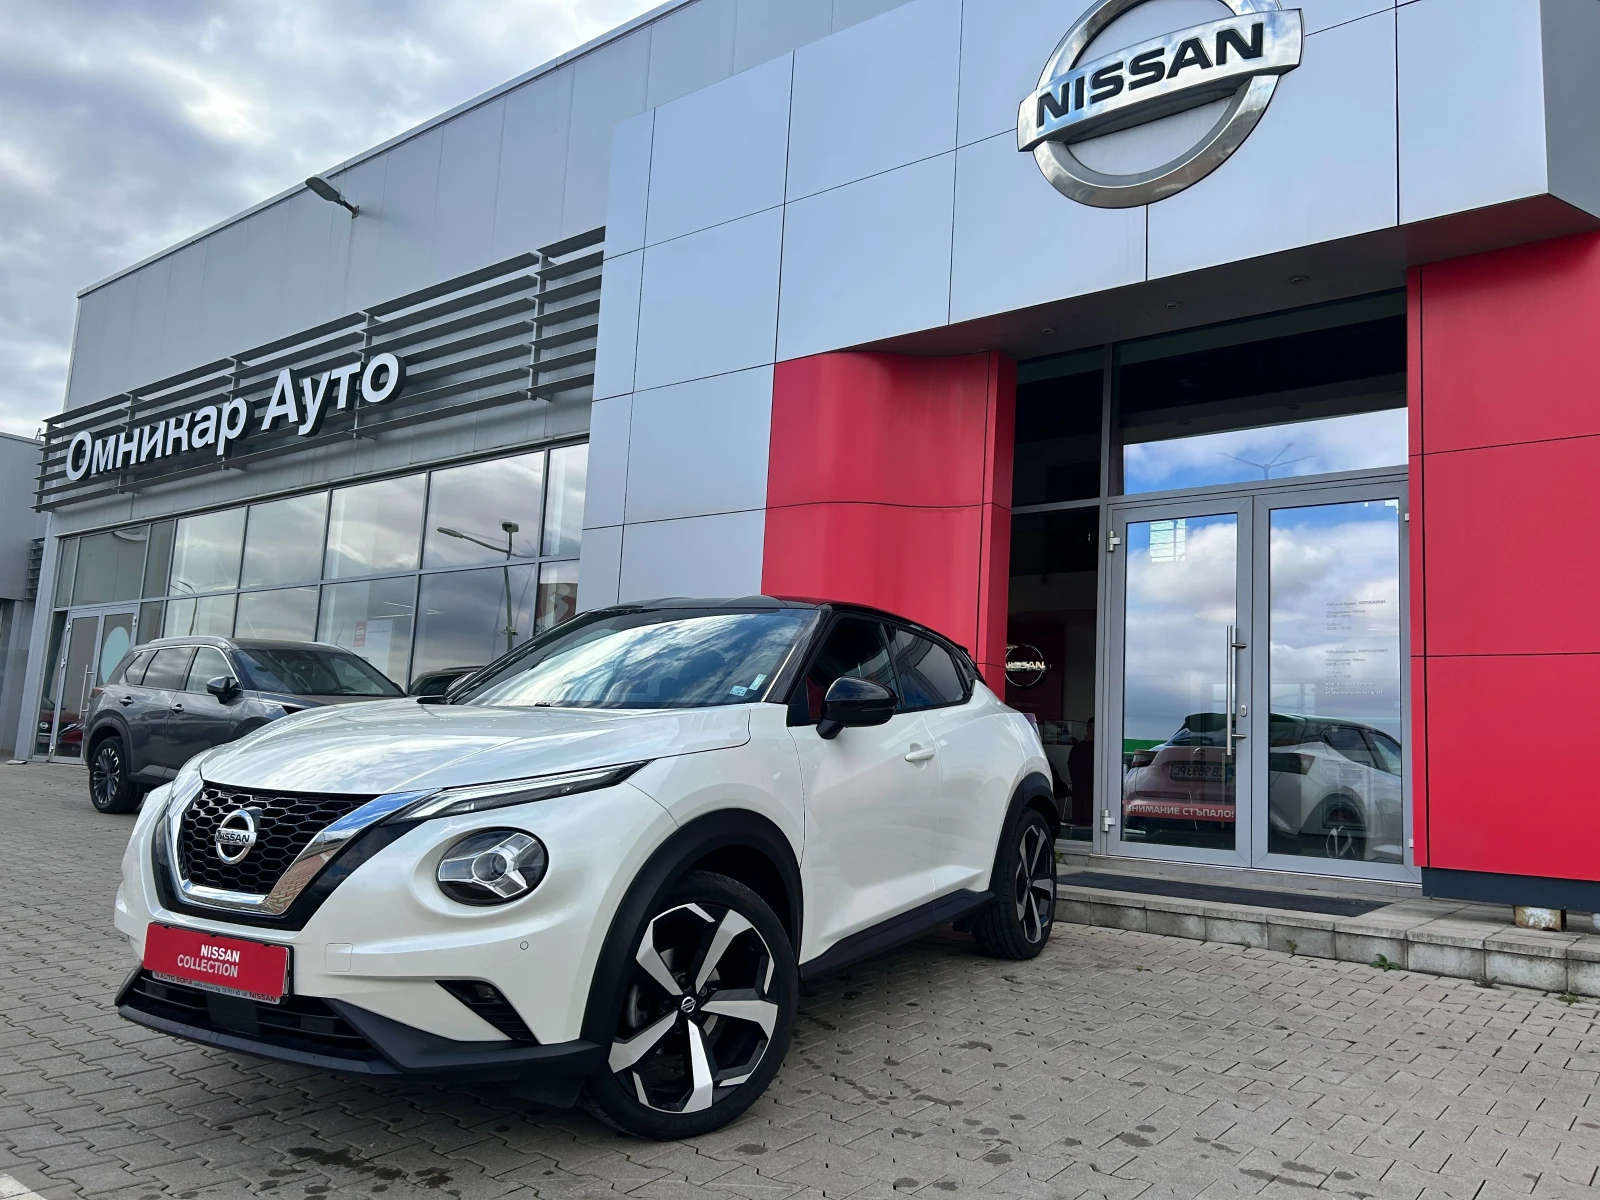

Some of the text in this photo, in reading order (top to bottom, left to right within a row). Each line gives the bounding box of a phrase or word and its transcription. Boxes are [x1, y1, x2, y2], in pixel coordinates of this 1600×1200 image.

[1037, 23, 1264, 128] NISSAN
[66, 352, 400, 481] Омникар Ауто
[1125, 804, 1234, 818] ВНИМАНИЕ СТЪПАЛО!
[200, 944, 240, 963] NISSAN
[177, 954, 239, 978] COLLECTION
[249, 991, 277, 1003] NISSAN
